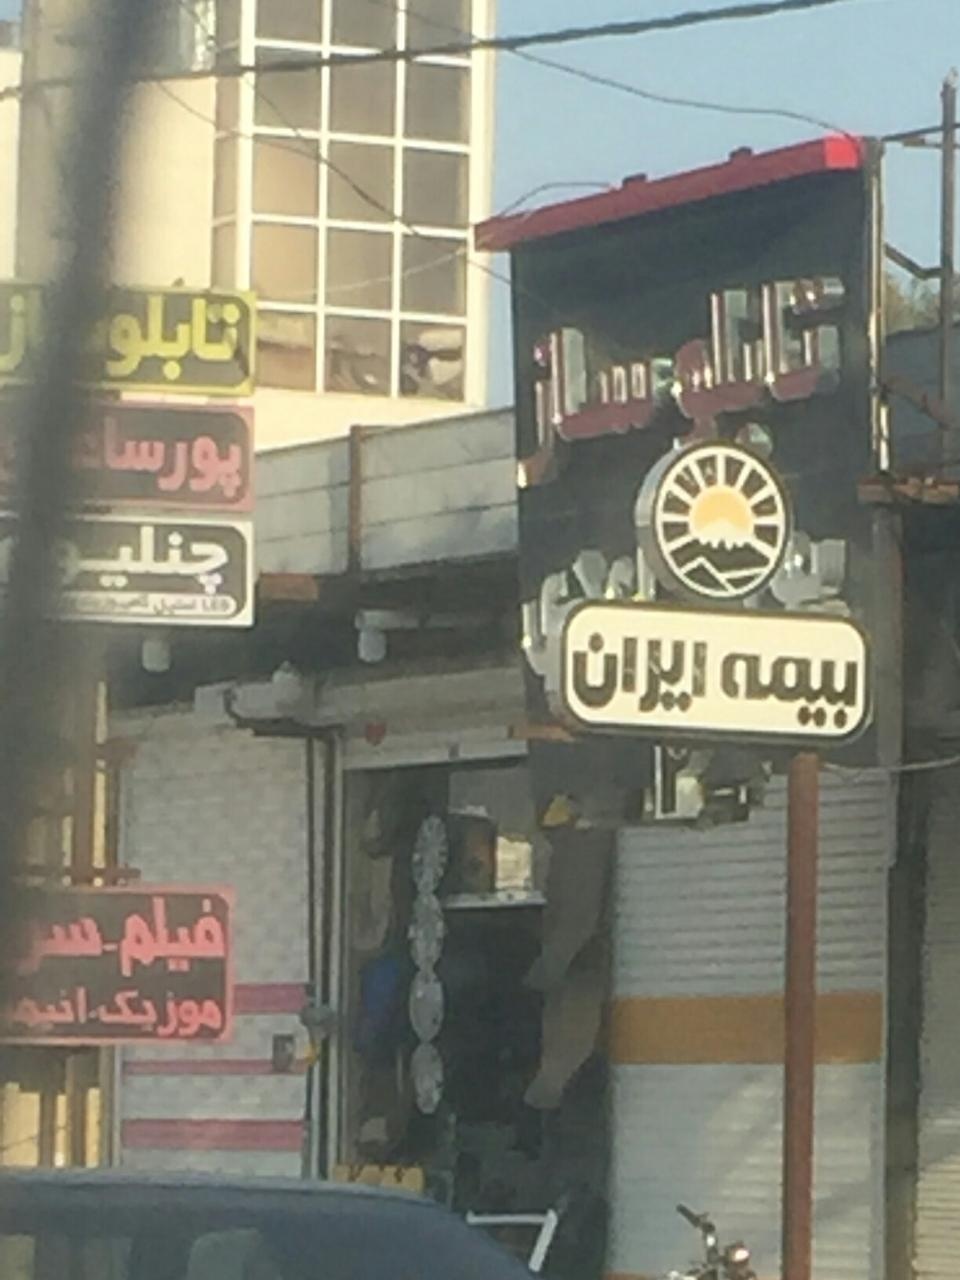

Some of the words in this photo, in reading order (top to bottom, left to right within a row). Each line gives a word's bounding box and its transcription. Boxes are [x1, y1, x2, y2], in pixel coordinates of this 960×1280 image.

[105, 293, 240, 381] تابلو
[72, 417, 243, 498] پورسا
[571, 632, 708, 713] ایران
[719, 652, 858, 730] بیمه
